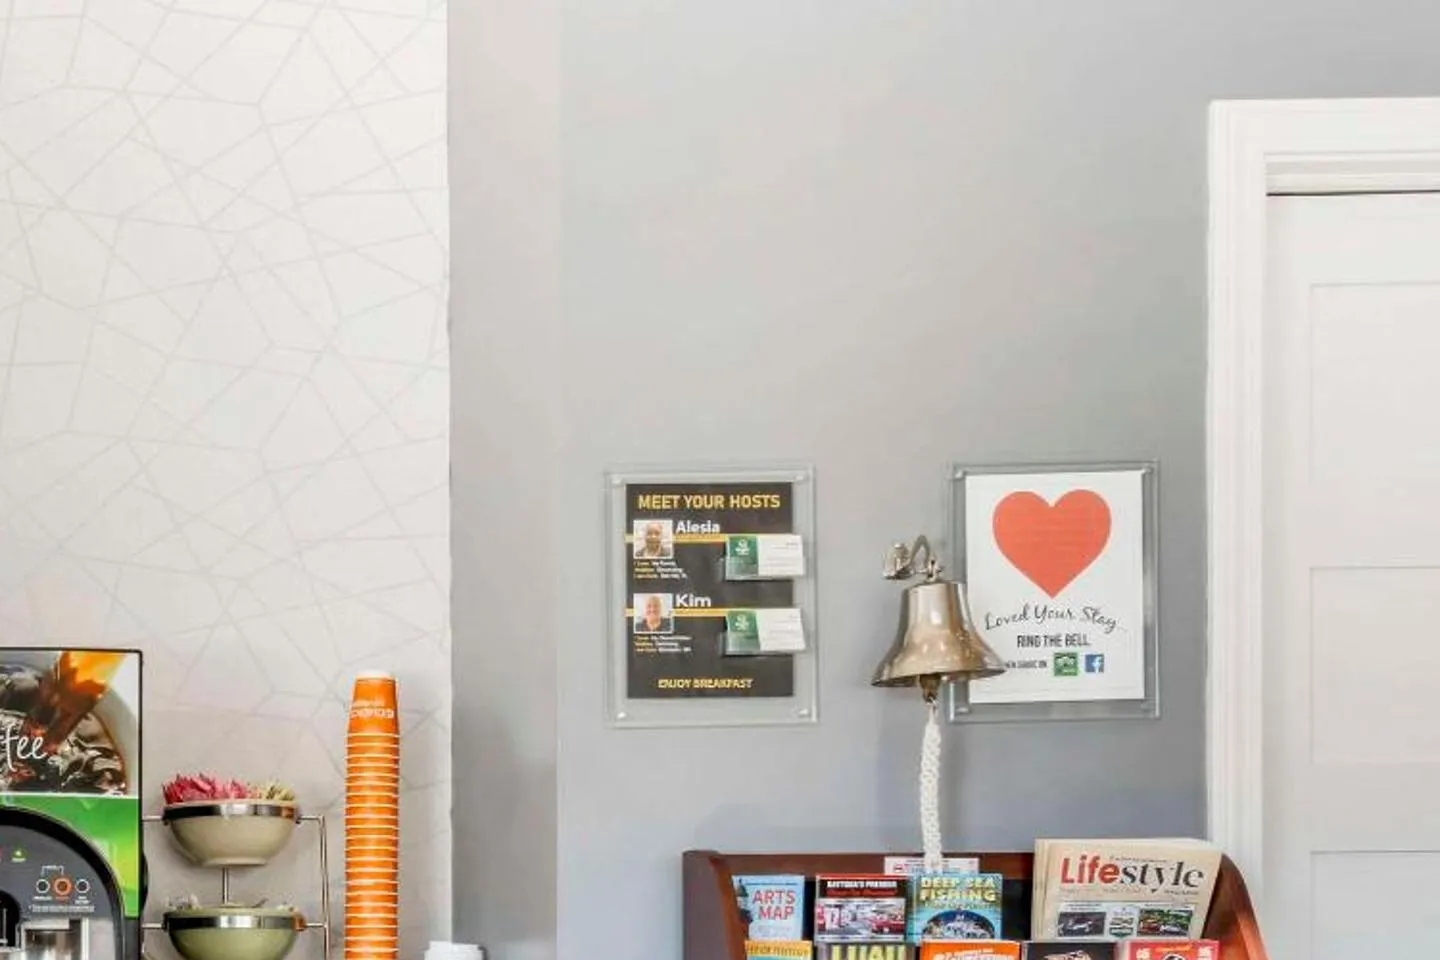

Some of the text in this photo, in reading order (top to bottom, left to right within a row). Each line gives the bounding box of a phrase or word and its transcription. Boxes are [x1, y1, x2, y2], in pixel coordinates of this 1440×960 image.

[638, 494, 781, 509] MEET YOUR HOSTS
[676, 520, 720, 533] Alesia
[676, 593, 711, 607] Kim
[985, 603, 1029, 630] Loved
[1034, 605, 1076, 625] Your
[1017, 633, 1091, 648] RING THE BELL
[658, 678, 754, 689] ENJOY BREAKFAST
[1060, 855, 1204, 894] Lifestyle
[920, 876, 996, 888] DEEP SEA
[752, 890, 796, 904] ARTS
[920, 888, 997, 902] FISHING
[758, 906, 795, 920] MAP
